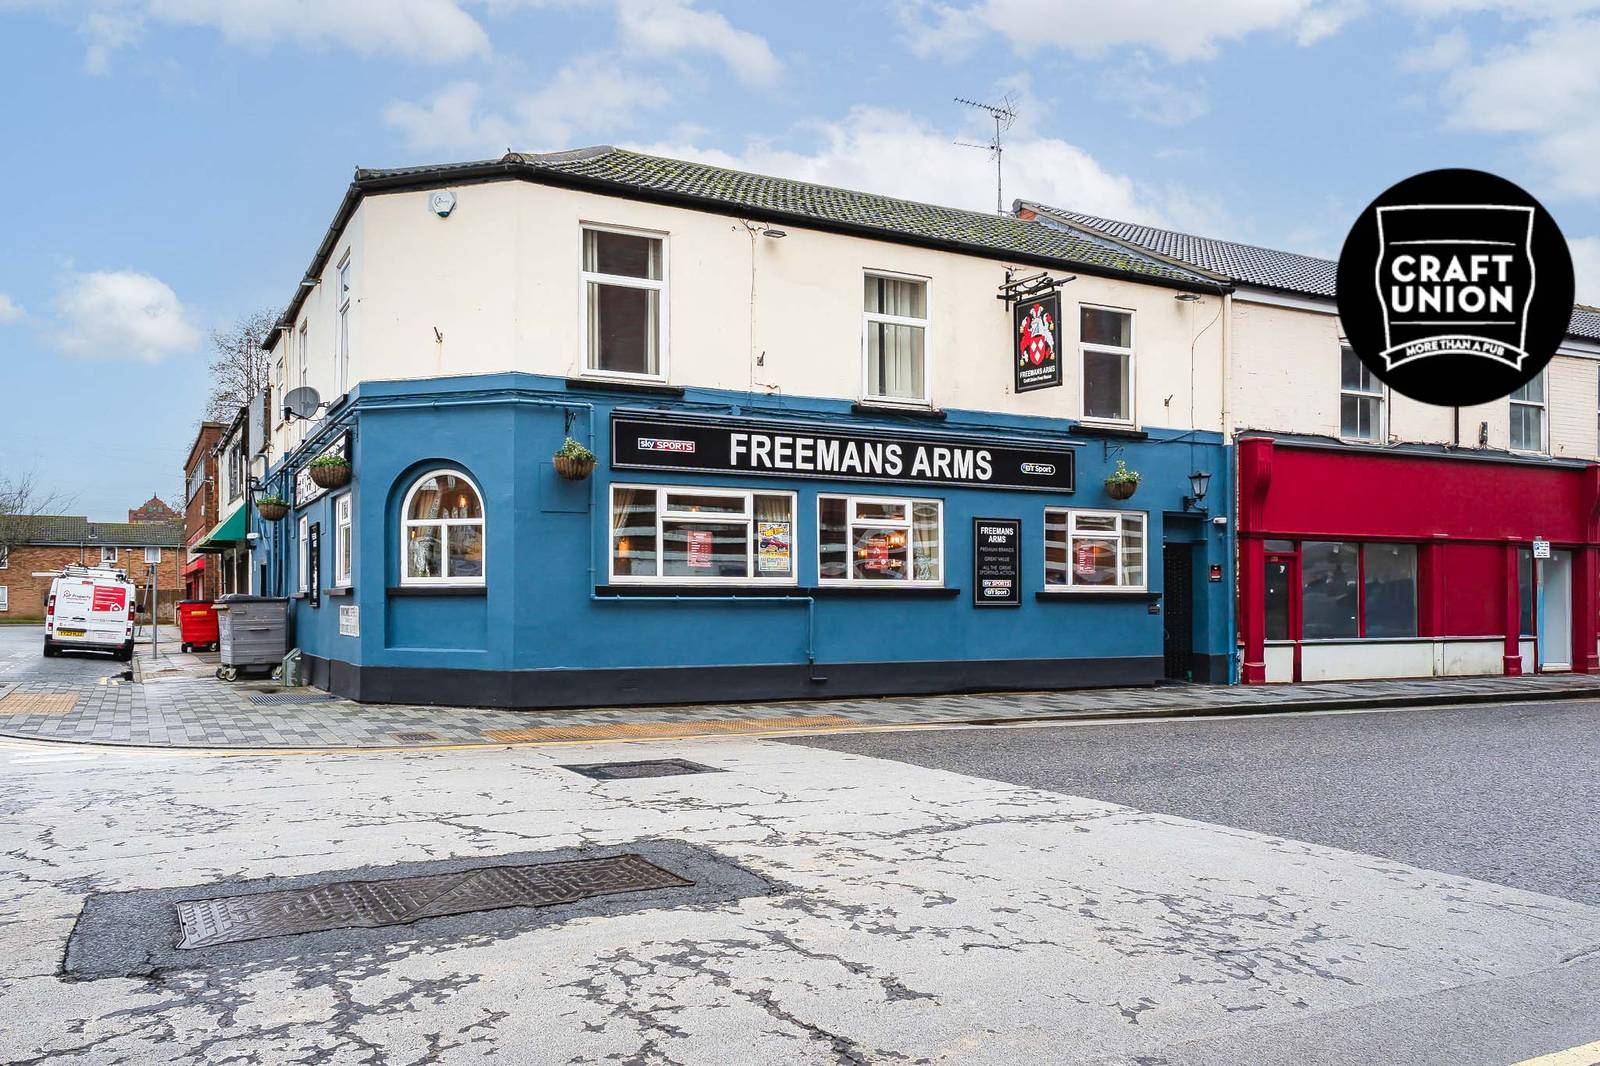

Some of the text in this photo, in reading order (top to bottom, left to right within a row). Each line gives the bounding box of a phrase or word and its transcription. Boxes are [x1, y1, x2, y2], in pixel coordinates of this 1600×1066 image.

[1020, 365, 1055, 378] FREEMANS ARMS
[640, 440, 693, 451] sky SPORTS
[730, 433, 993, 480] FREEMANS ARMS
[1035, 465, 1052, 473] Sport
[980, 527, 1014, 535] FREEMANS
